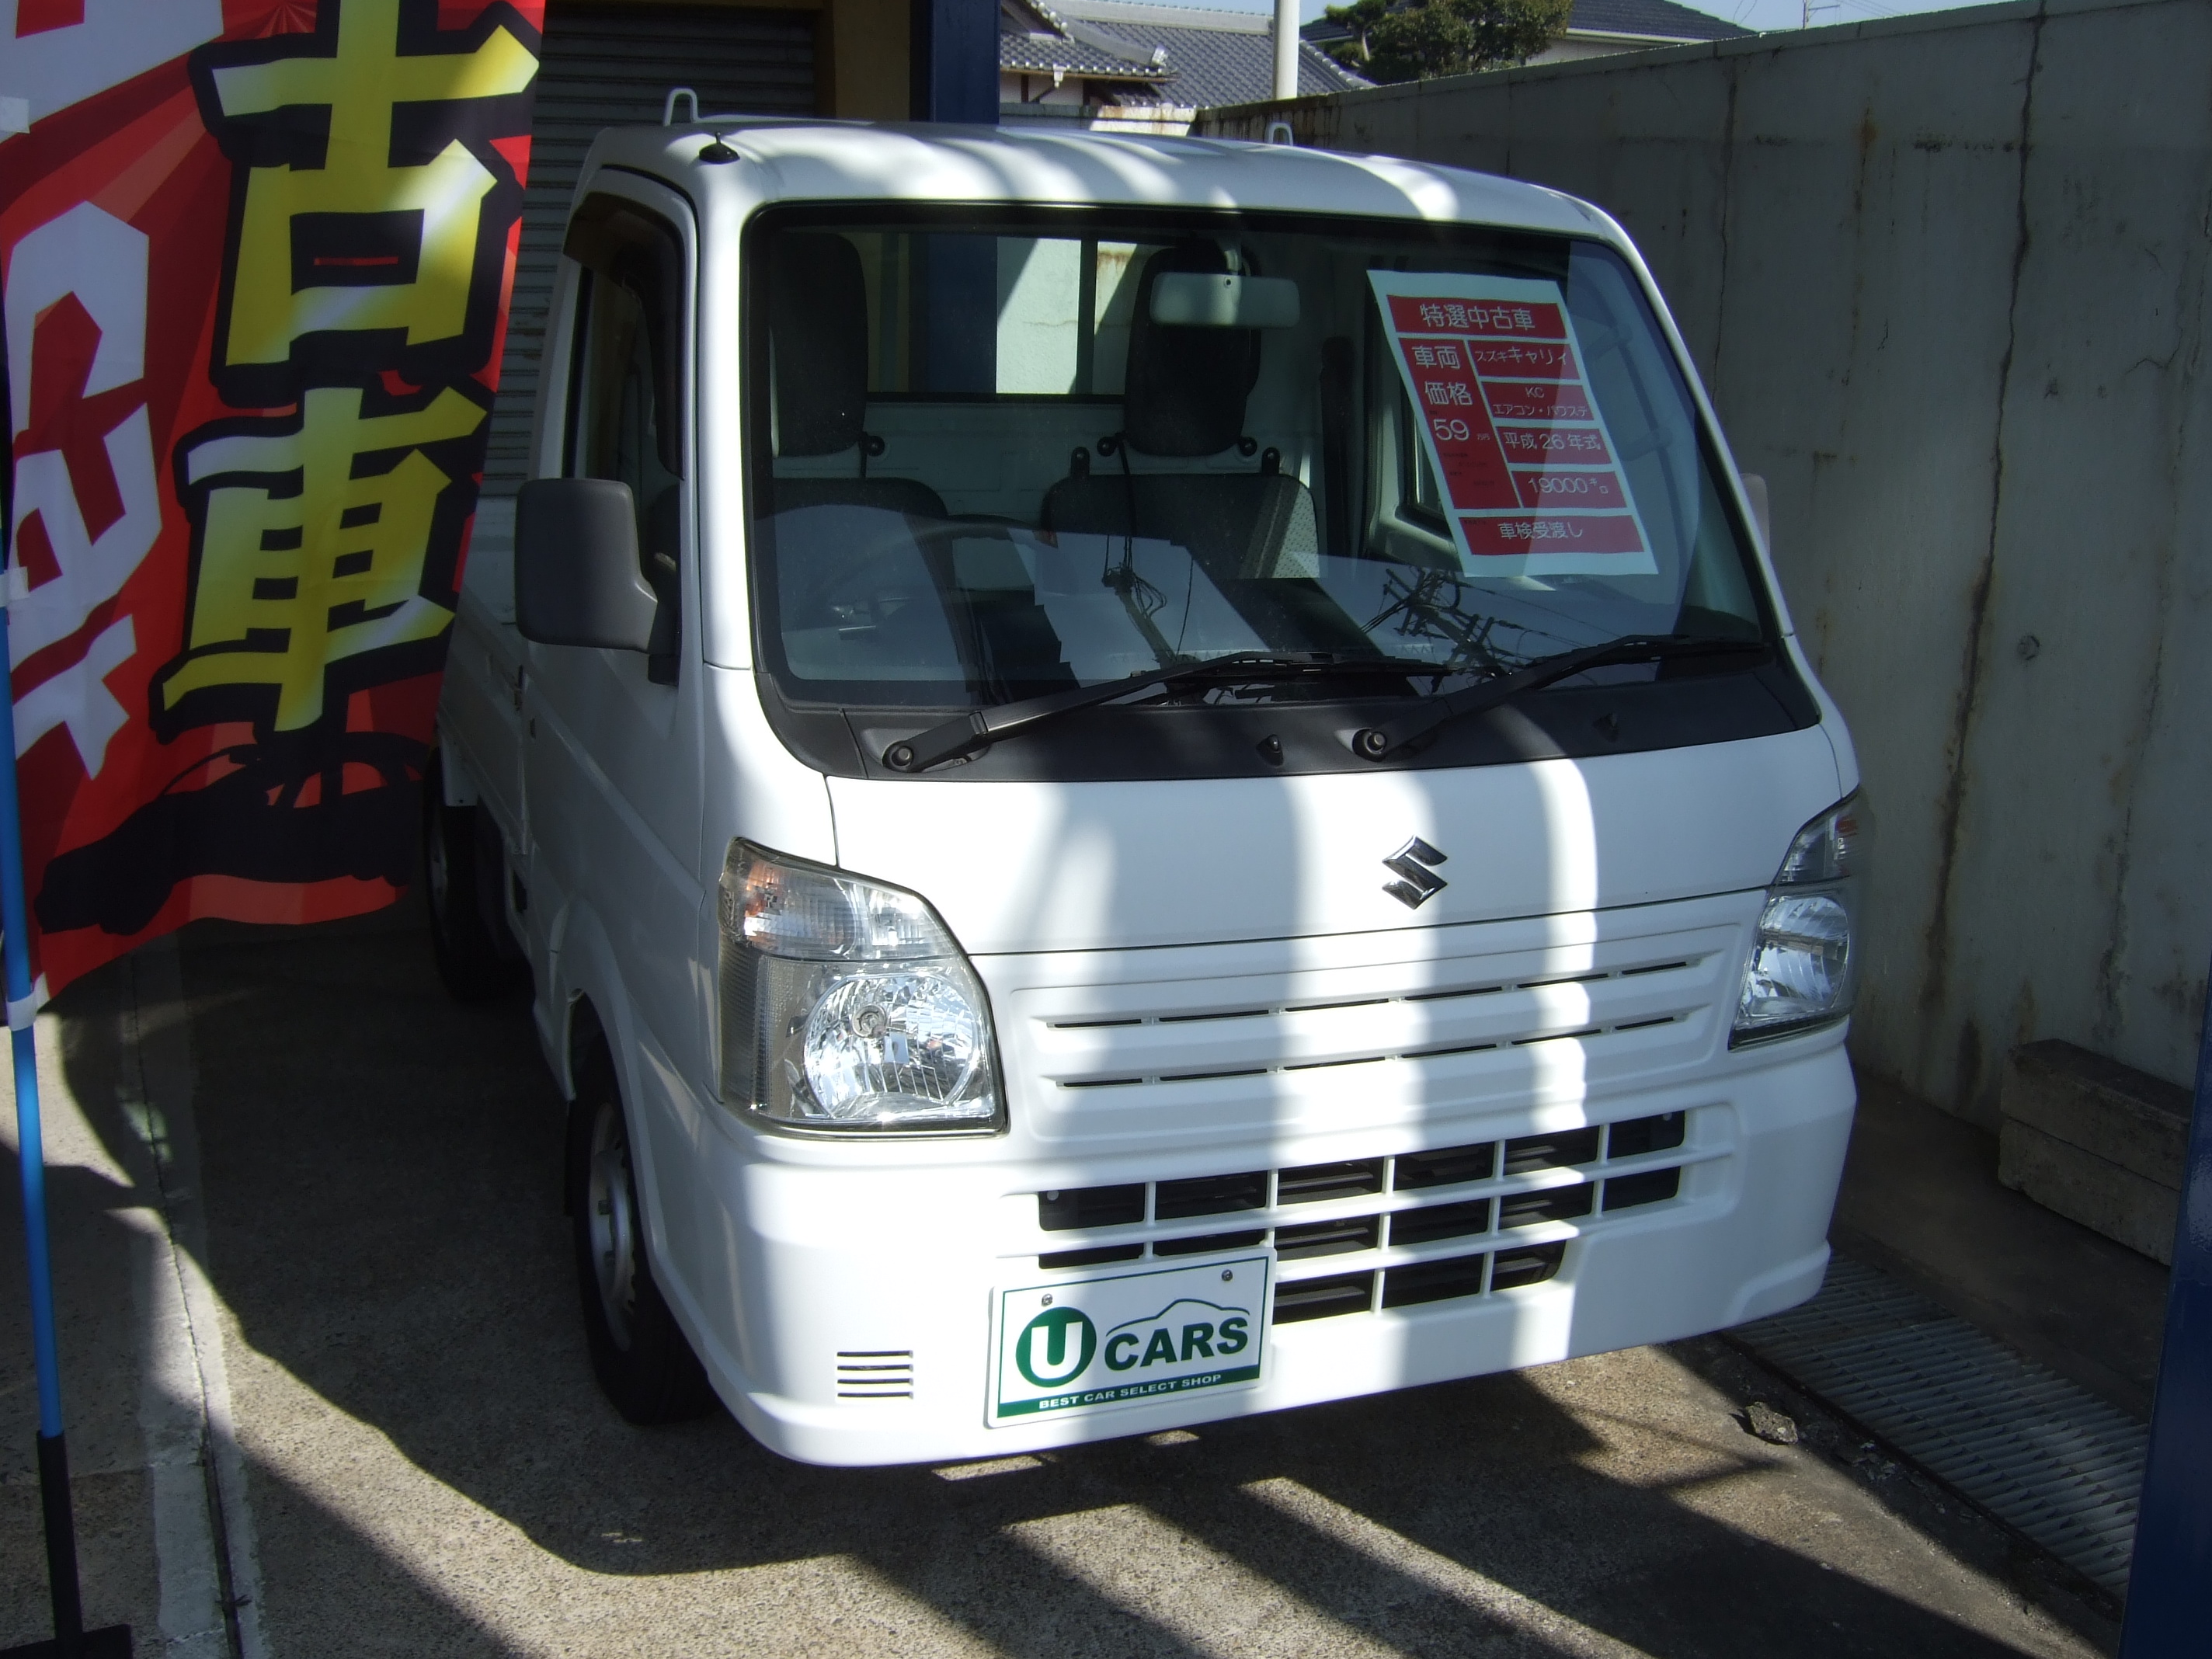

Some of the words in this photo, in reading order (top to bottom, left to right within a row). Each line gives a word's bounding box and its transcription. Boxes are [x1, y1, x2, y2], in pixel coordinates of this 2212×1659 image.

[1419, 303, 1536, 331] 特選中古車
[1410, 345, 1461, 370] 車両
[1423, 381, 1474, 406] 価格
[1525, 386, 1546, 398] KC
[1432, 418, 1471, 442] 59
[1497, 521, 1584, 540] 車検受渡し
[1029, 1320, 1084, 1380] U
[1104, 1316, 1249, 1372] CARS
[1038, 1395, 1080, 1410] BEST
[1083, 1389, 1115, 1403] CAR
[1119, 1380, 1177, 1397] SELECT
[1181, 1373, 1222, 1388] SHOP
